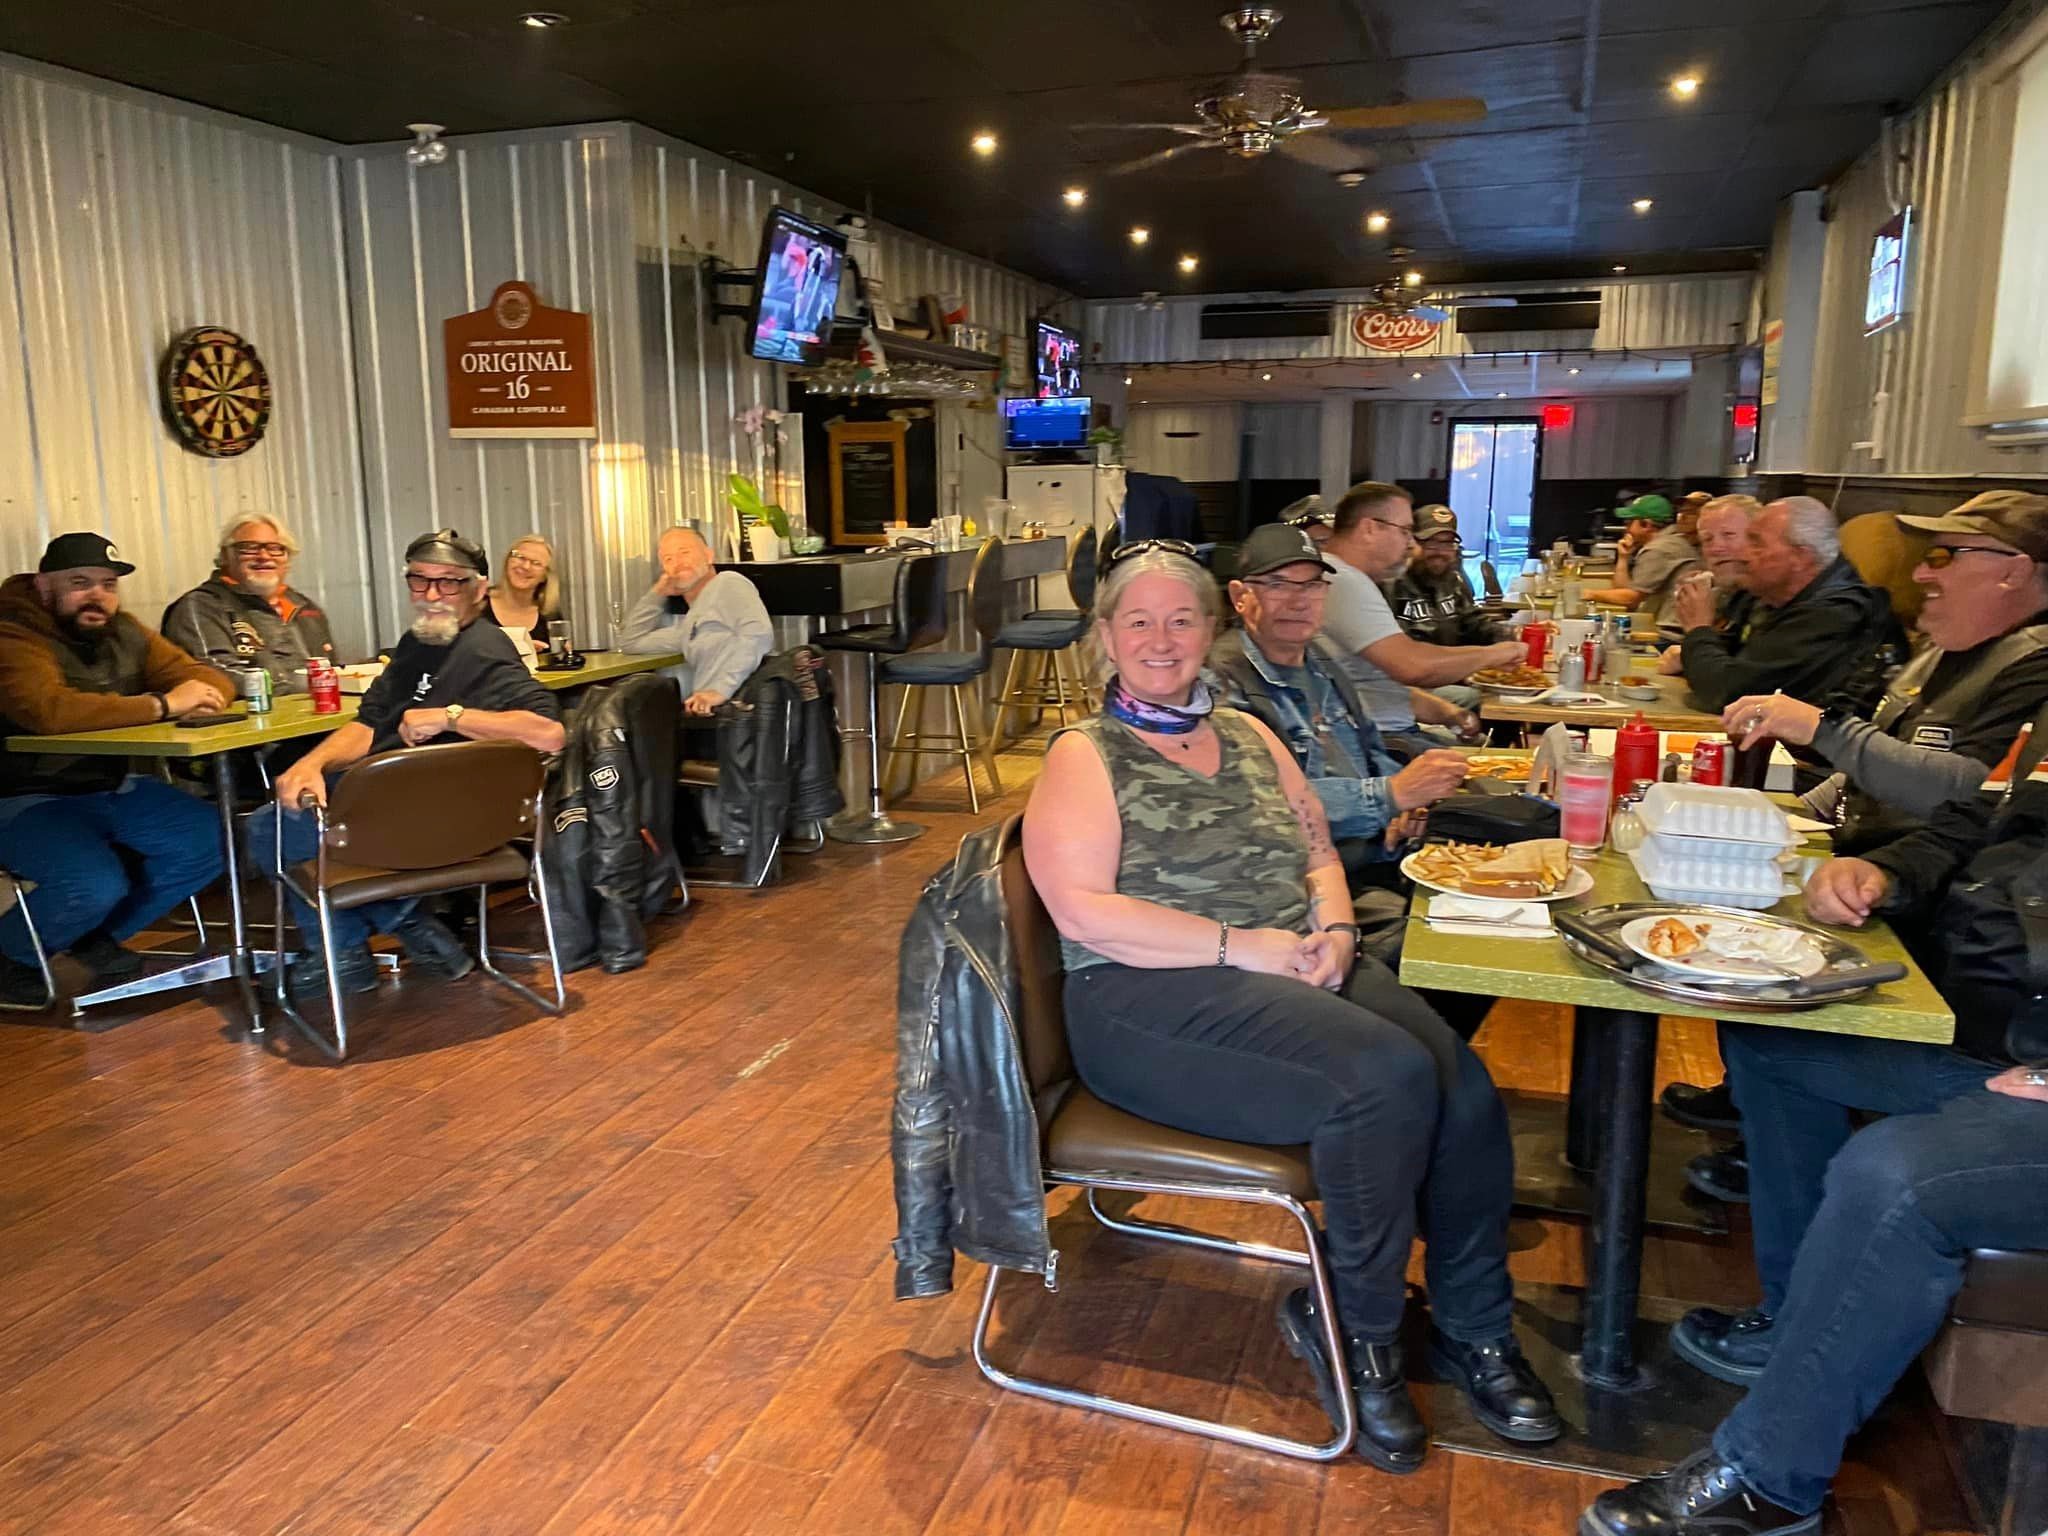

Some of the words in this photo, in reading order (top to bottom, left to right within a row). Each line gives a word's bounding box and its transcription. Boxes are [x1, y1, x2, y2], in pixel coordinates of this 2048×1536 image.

[1363, 313, 1431, 338] Coors
[461, 351, 572, 373] ORIGINAL
[505, 374, 530, 399] 16
